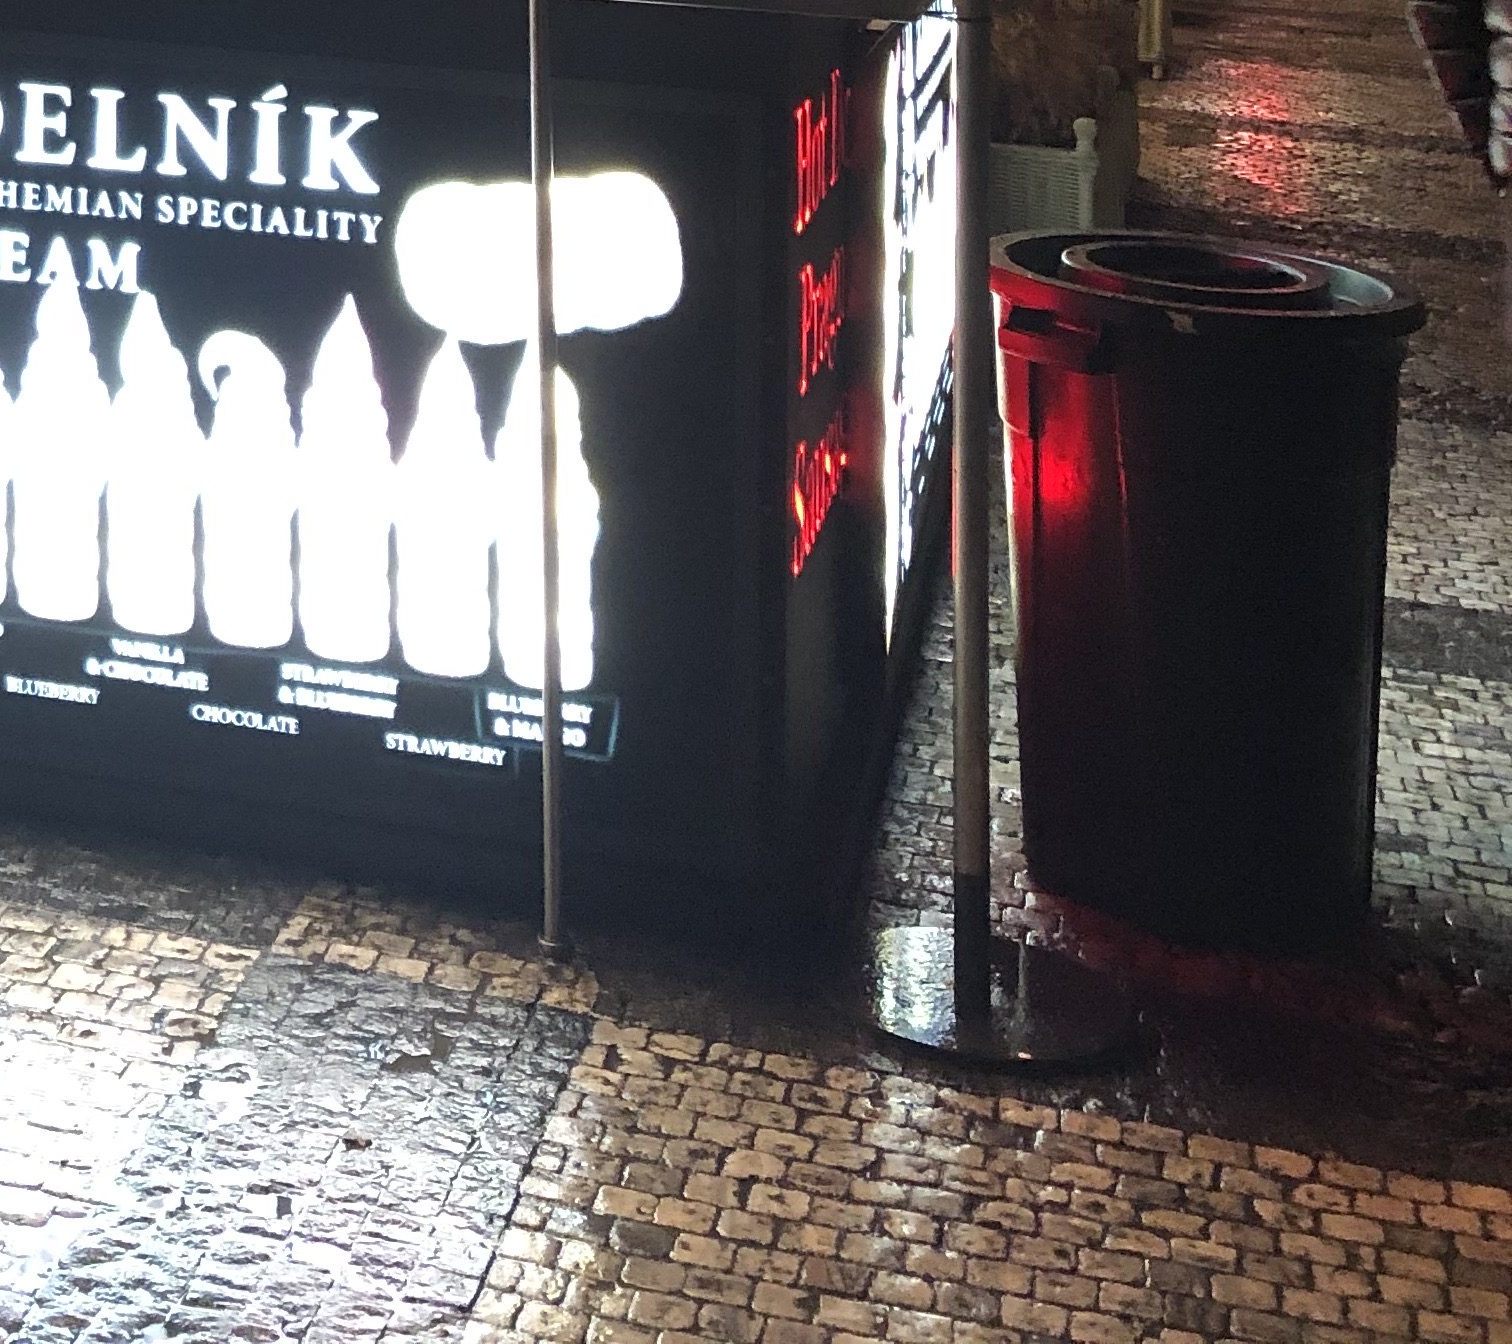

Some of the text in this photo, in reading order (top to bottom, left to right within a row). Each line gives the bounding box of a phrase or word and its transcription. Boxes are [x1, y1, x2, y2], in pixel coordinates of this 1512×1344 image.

[156, 193, 384, 244] SPECIALITY
[3, 673, 100, 706] BLUEBERRY
[190, 703, 301, 736] CHOCOLATE
[385, 732, 506, 767] STRAWBERRY
